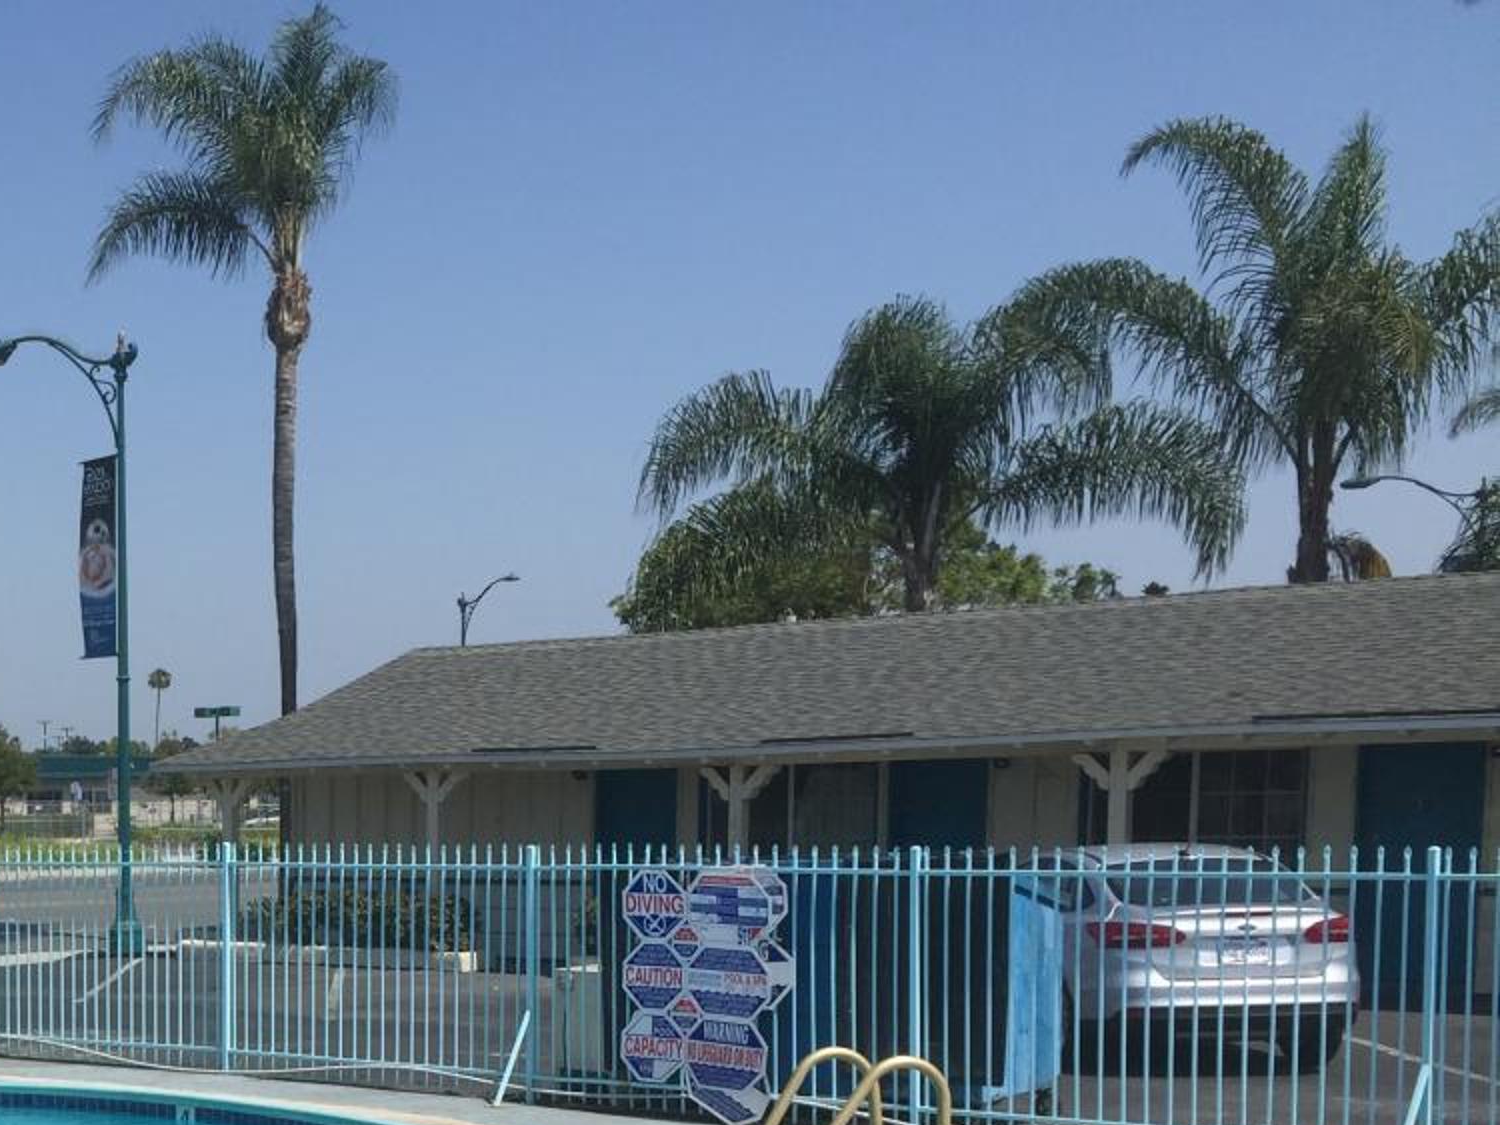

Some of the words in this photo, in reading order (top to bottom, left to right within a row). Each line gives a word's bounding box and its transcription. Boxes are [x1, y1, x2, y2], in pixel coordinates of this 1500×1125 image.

[643, 873, 667, 893] NO
[626, 895, 684, 914] DIVING
[626, 967, 682, 986] CAUTION
[703, 1021, 749, 1044] WARNING
[624, 1036, 683, 1057] CAPACITY
